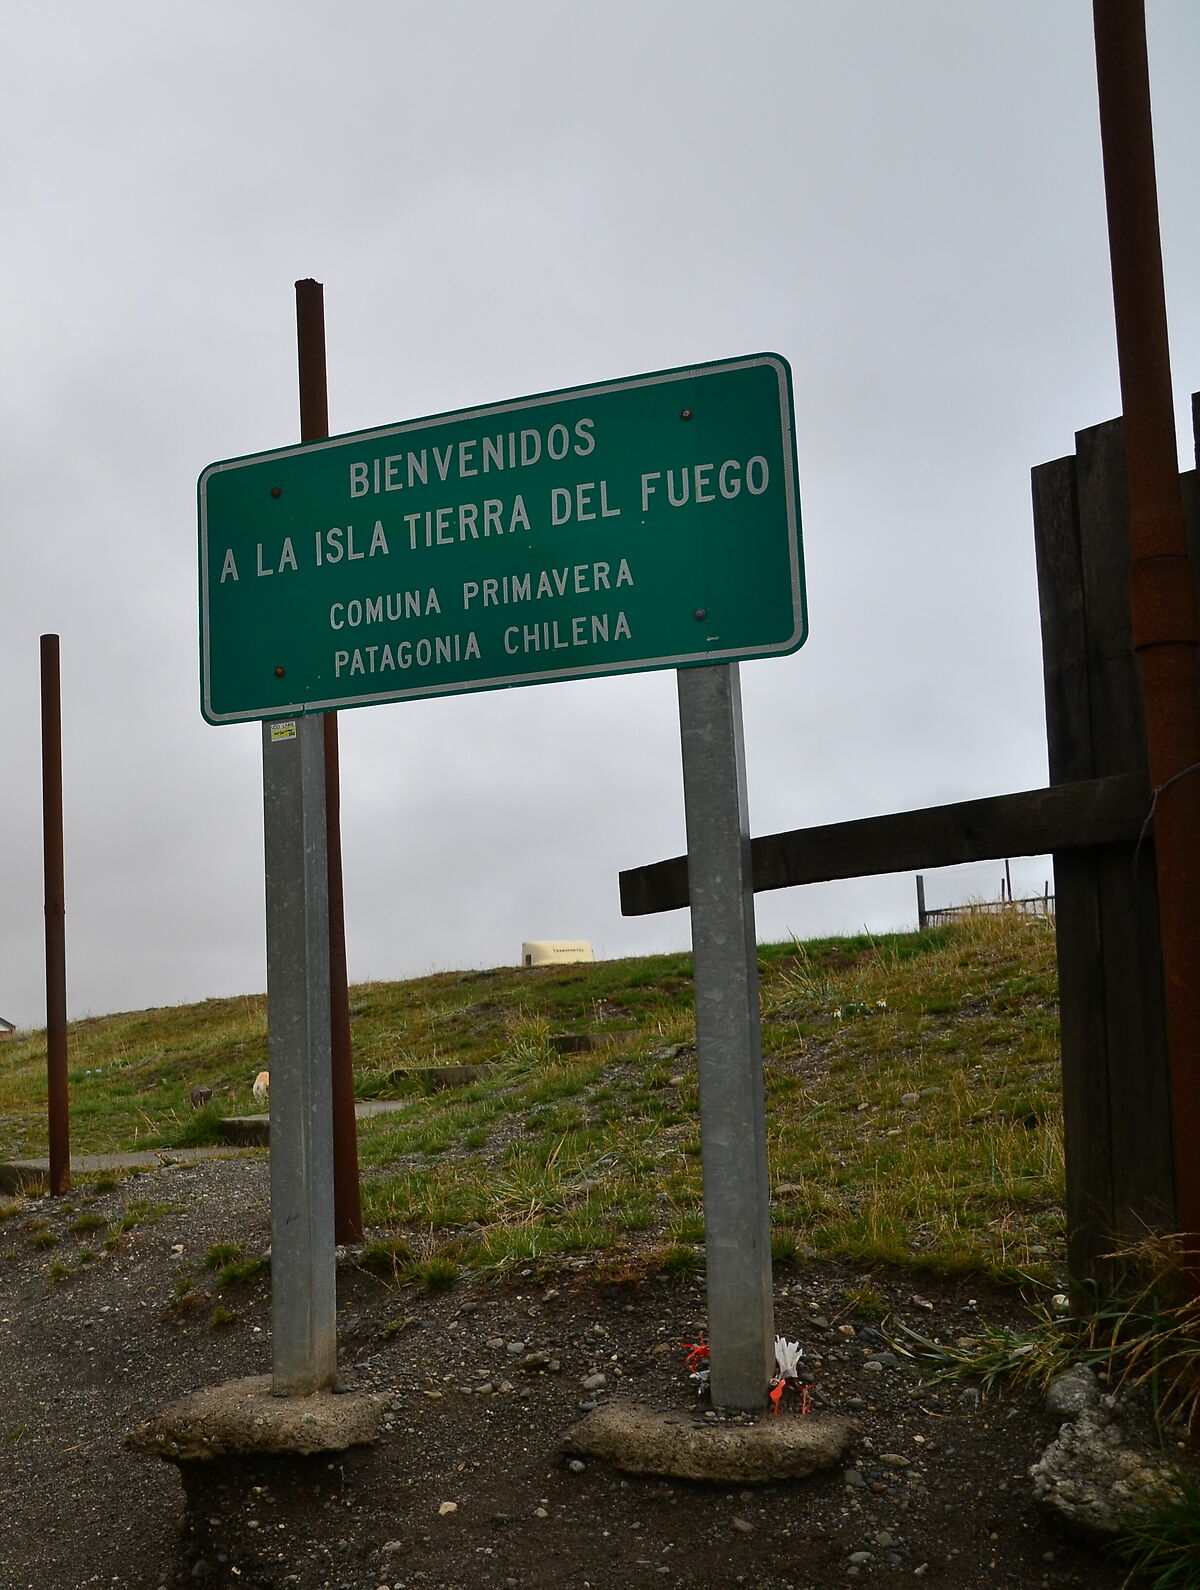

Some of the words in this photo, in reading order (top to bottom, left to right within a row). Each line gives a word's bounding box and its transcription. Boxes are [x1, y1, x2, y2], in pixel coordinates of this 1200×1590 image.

[349, 417, 596, 499] BIENVENIDOS
[219, 548, 240, 585] A
[256, 536, 299, 578] LA
[315, 520, 389, 567] ISLA
[403, 494, 531, 551] TIERRA
[550, 480, 621, 527] DEL
[641, 454, 771, 512] FUEGO
[329, 587, 442, 631] COMUNA
[462, 557, 635, 610] PRIMAVERA
[334, 632, 482, 678] PATAGONIA
[503, 610, 633, 656] CHILENA
